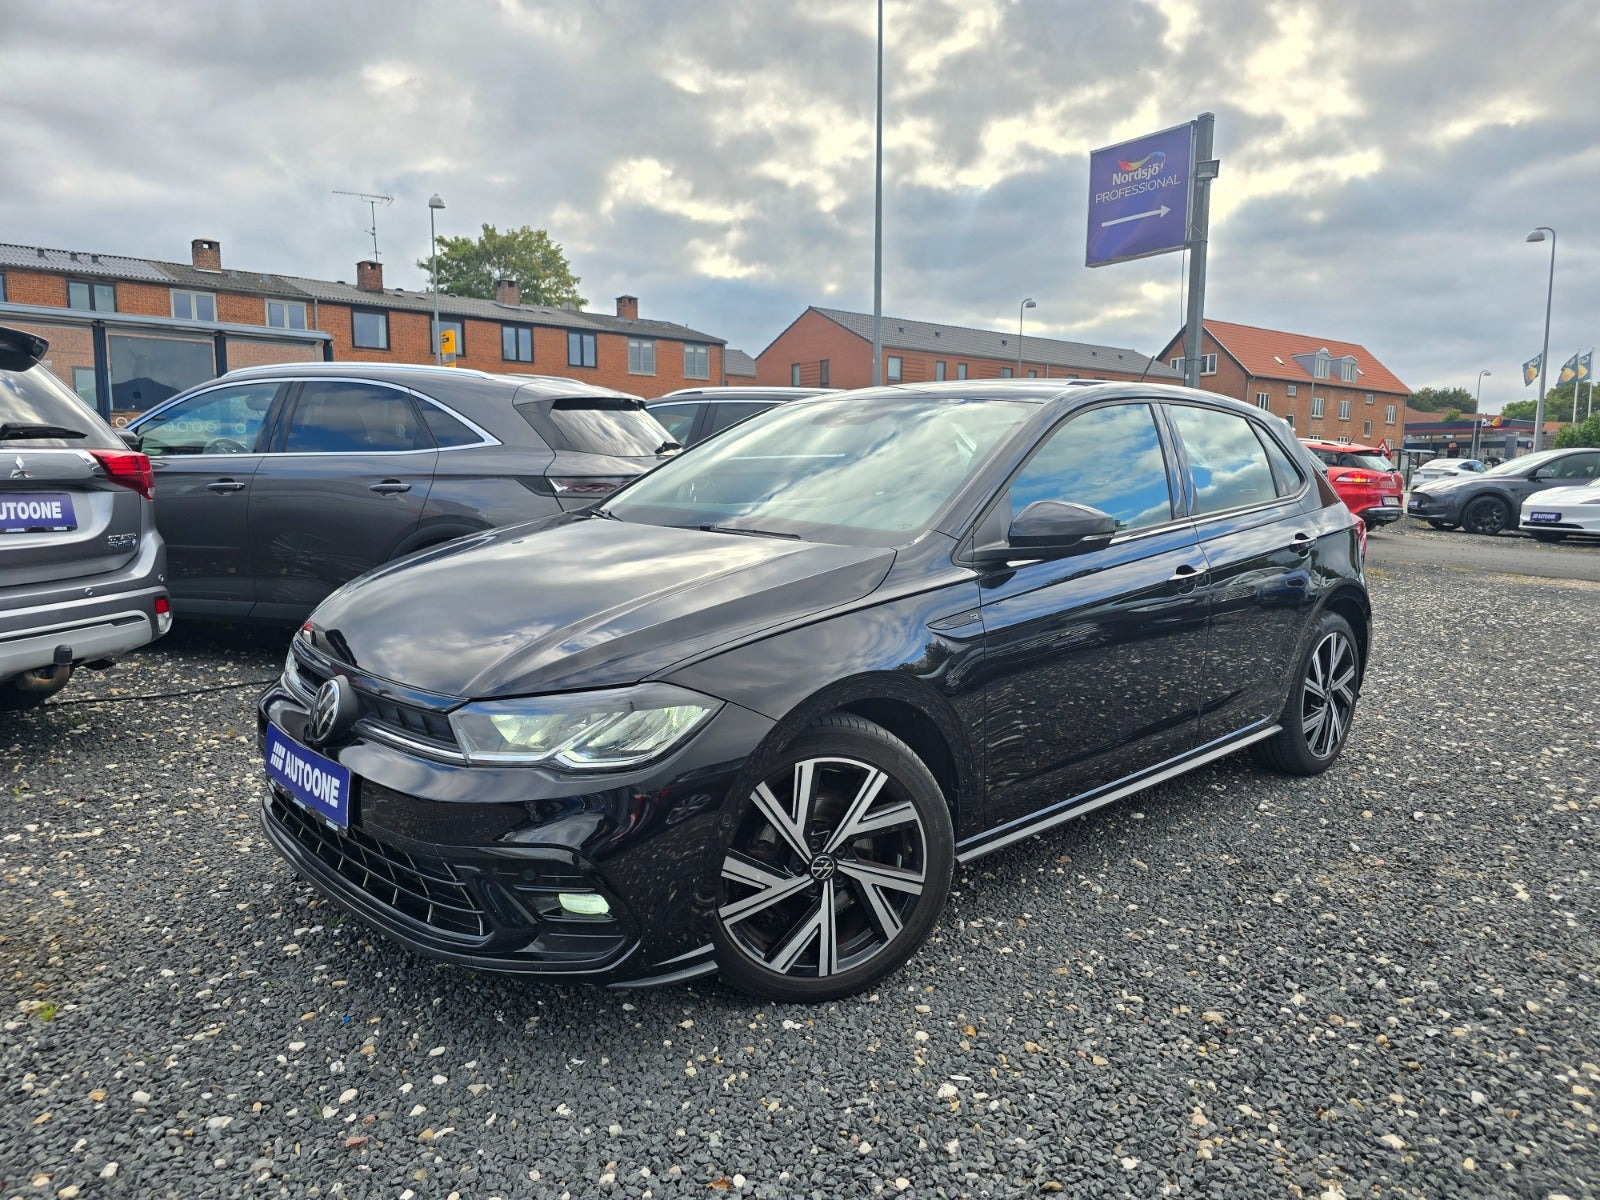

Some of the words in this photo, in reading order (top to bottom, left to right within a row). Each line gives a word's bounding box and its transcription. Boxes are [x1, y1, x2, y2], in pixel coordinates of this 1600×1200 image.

[1095, 174, 1181, 204] PROFESSIONAL
[1112, 162, 1159, 186] Nordsjö
[284, 750, 340, 809] AUTOONE
